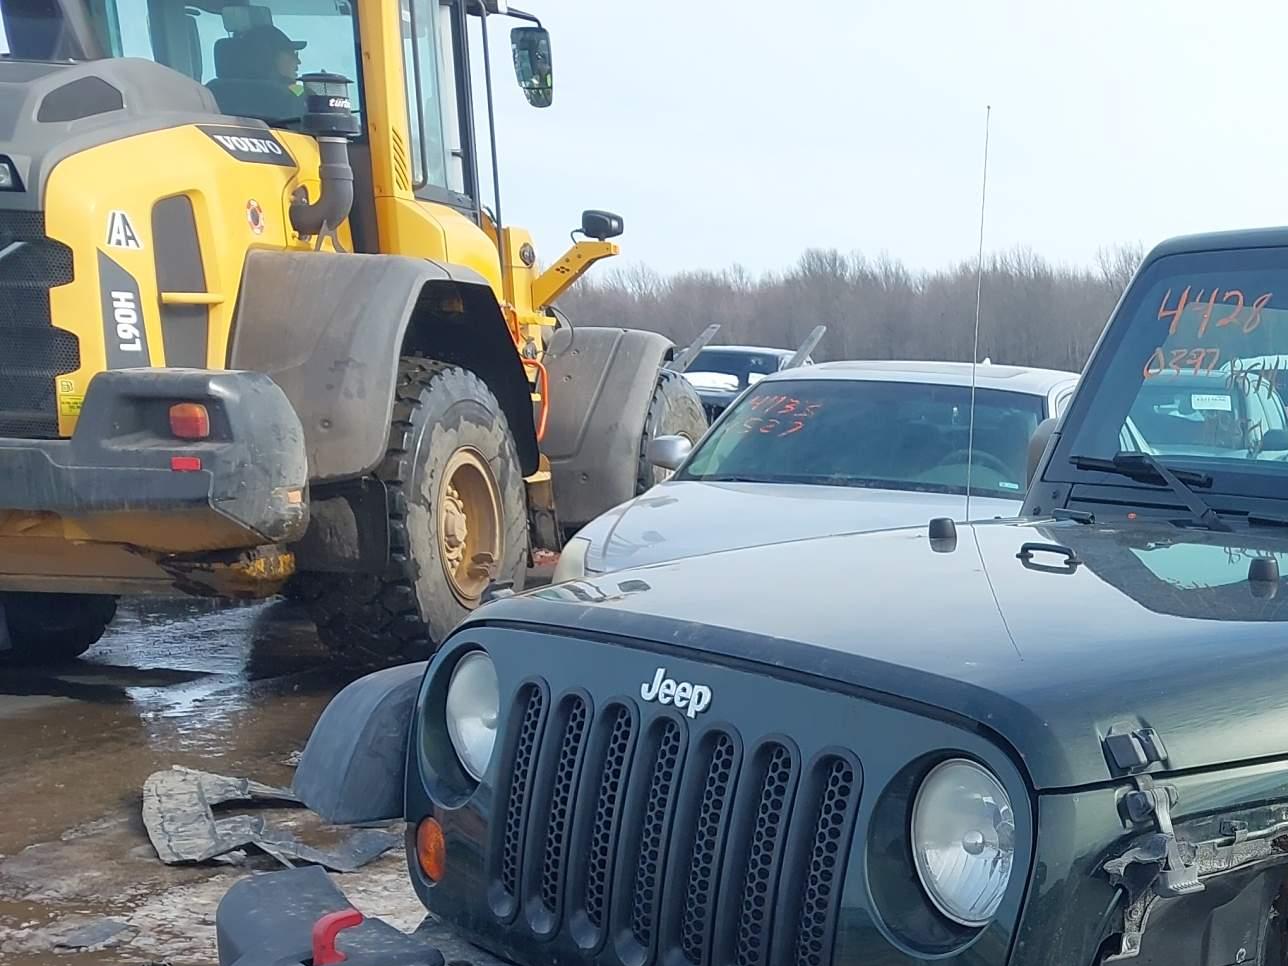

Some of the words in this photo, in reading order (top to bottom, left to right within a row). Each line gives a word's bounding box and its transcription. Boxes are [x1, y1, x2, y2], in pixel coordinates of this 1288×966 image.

[212, 134, 283, 155] VOLVO
[111, 291, 143, 352] L90H
[1158, 285, 1273, 337] 4428
[640, 667, 712, 718] Jeep
